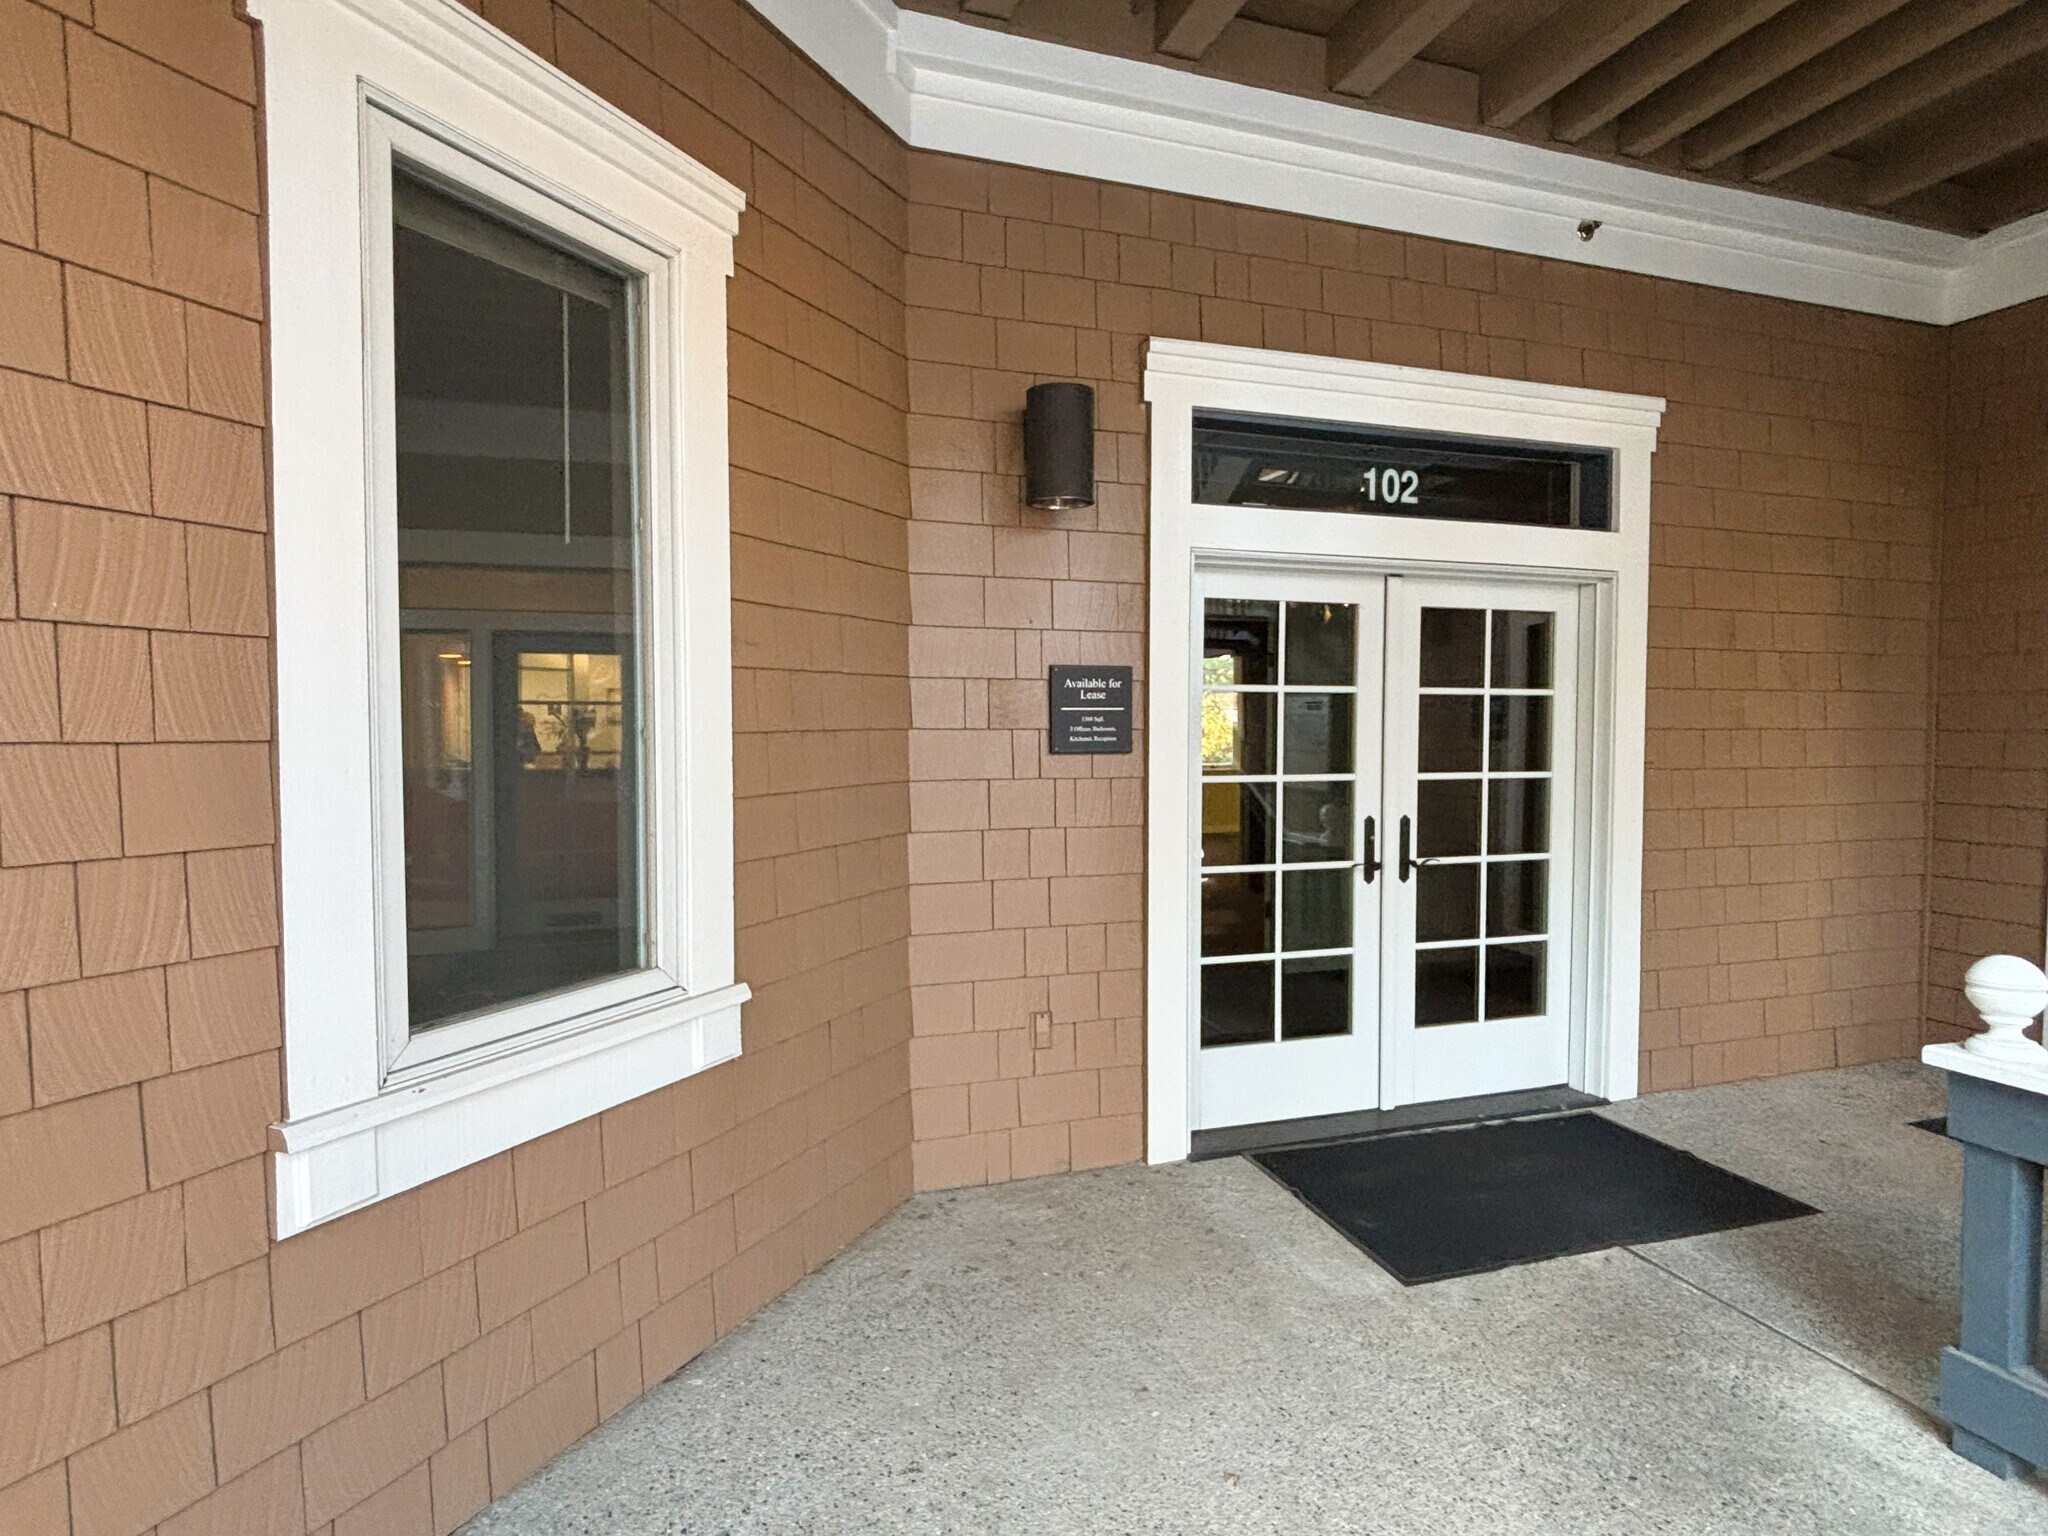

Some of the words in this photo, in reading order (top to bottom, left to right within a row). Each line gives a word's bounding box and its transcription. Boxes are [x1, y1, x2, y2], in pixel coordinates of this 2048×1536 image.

[1363, 467, 1419, 504] 102
[1064, 678, 1107, 688] Available
[1109, 678, 1122, 688] for
[1080, 690, 1106, 699] Lease
